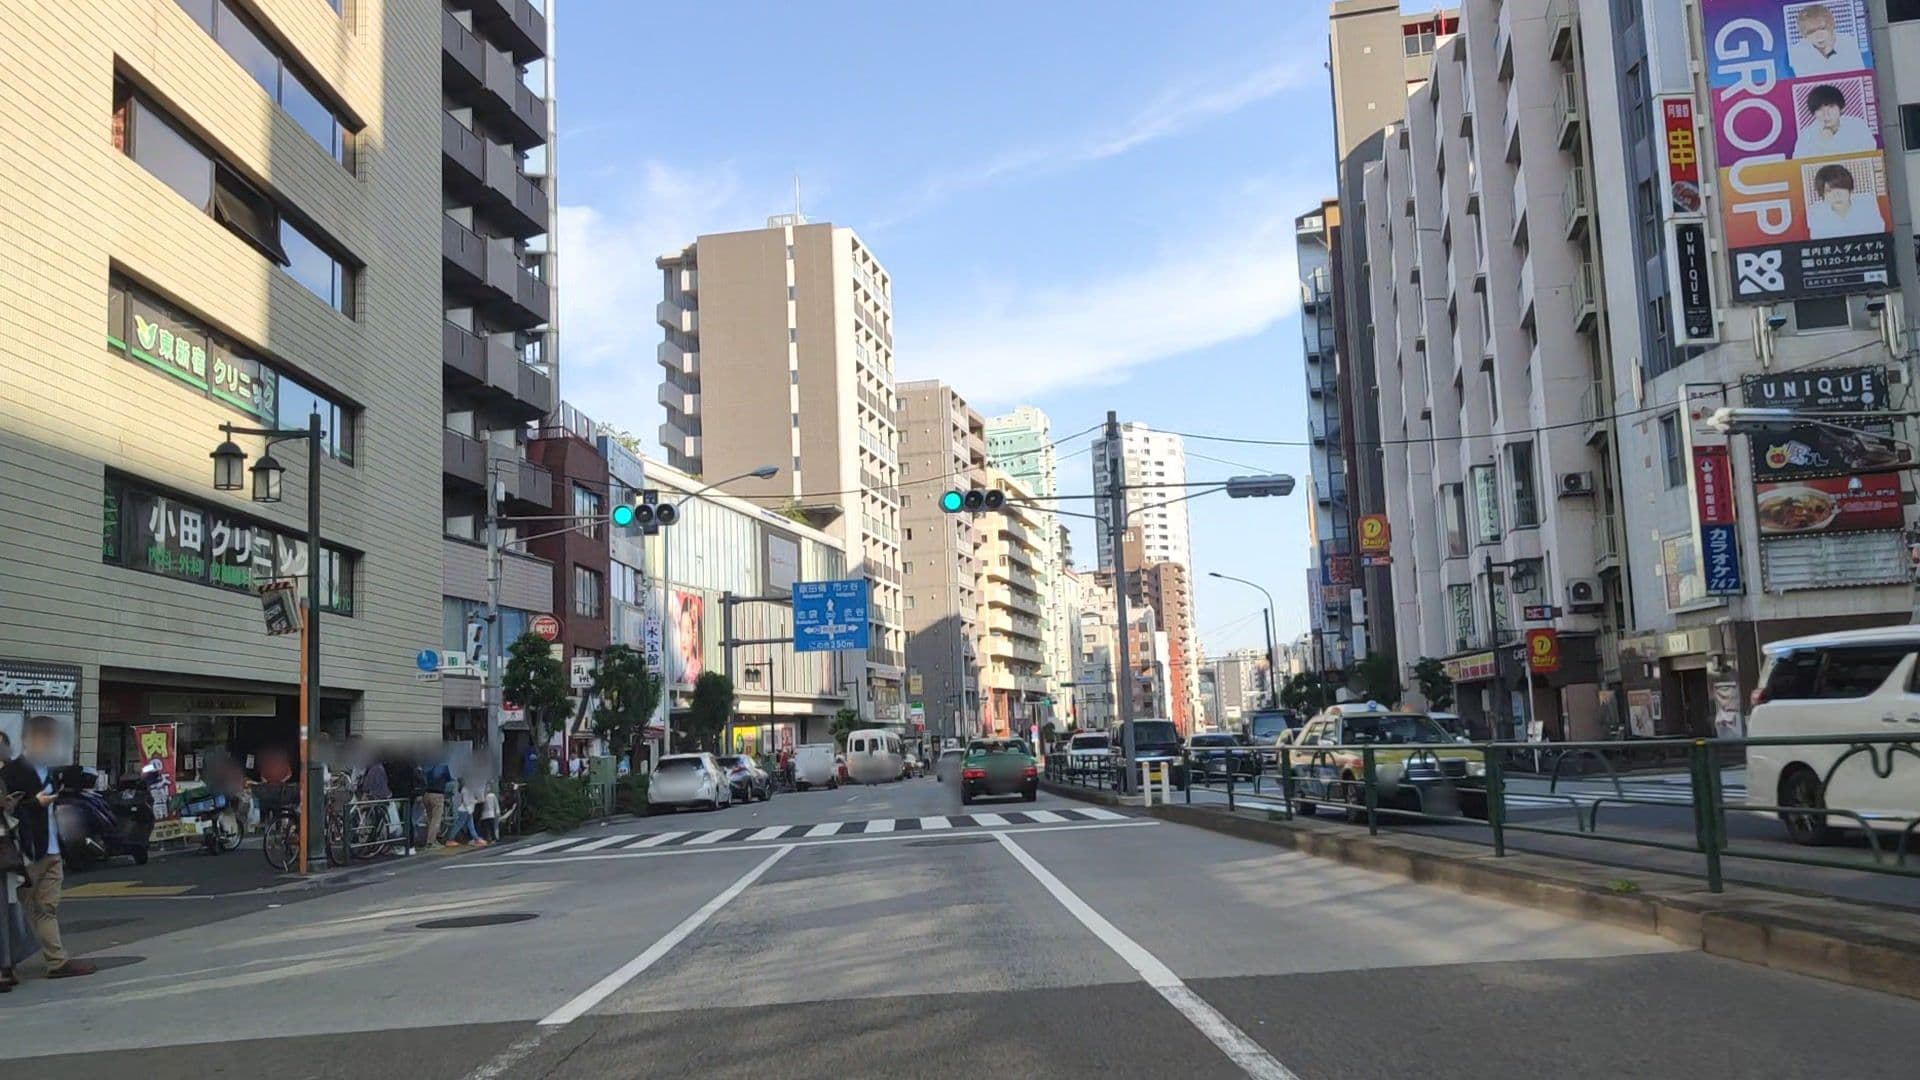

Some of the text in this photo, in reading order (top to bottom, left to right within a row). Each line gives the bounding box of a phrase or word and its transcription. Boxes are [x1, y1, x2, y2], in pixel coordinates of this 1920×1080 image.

[1715, 17, 1792, 236] GROUP
[1669, 128, 1695, 172] 串
[1686, 231, 1700, 305] UNIQUE
[1816, 252, 1885, 266] 0120-744-921
[1763, 374, 1873, 399] UNIQUE
[1709, 528, 1731, 578] カラオケ
[141, 730, 169, 759] 肉
